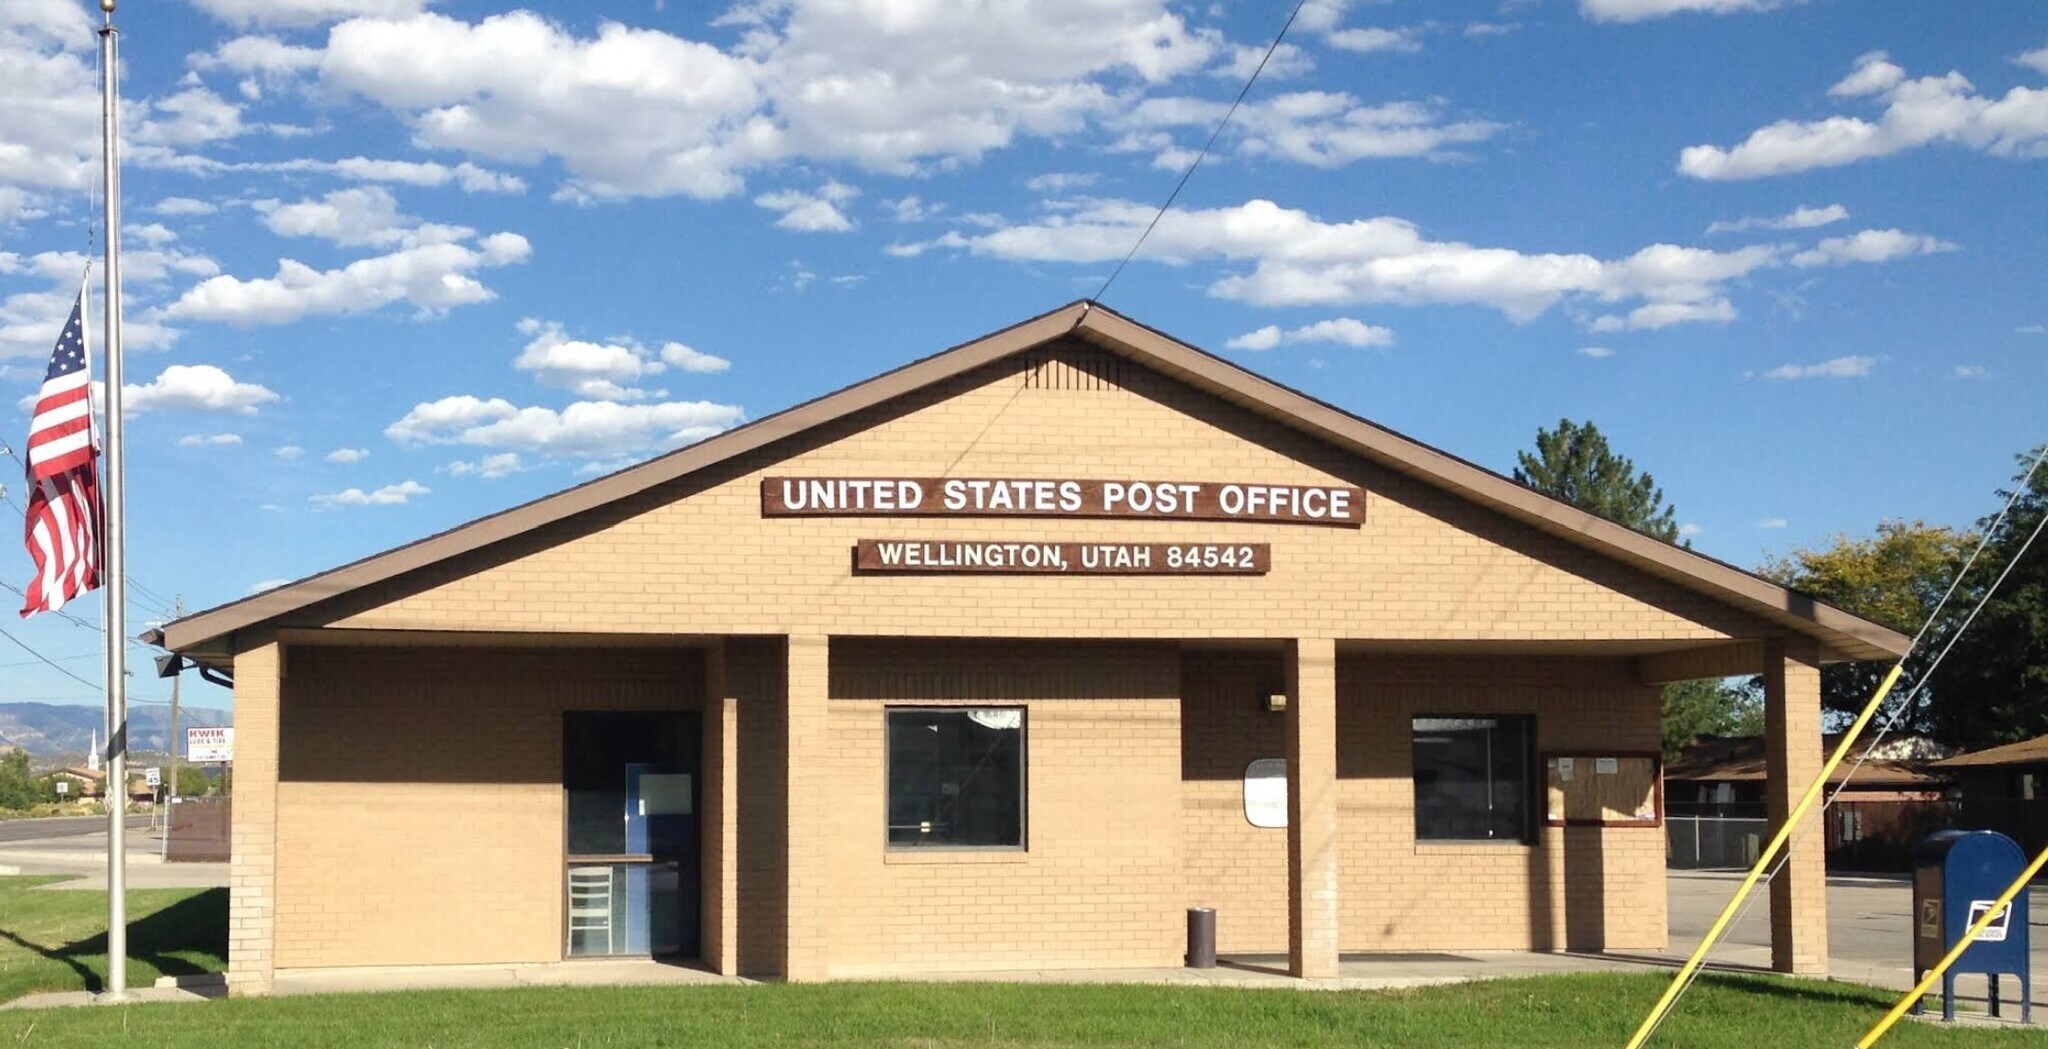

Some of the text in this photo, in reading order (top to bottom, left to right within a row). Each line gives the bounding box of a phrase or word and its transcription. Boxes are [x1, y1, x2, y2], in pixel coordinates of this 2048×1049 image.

[783, 480, 1351, 518] UNITED STATES POST OFFICE
[878, 543, 1254, 571] WELLINGTON, UTAH 84542
[189, 730, 225, 738] KWIK
